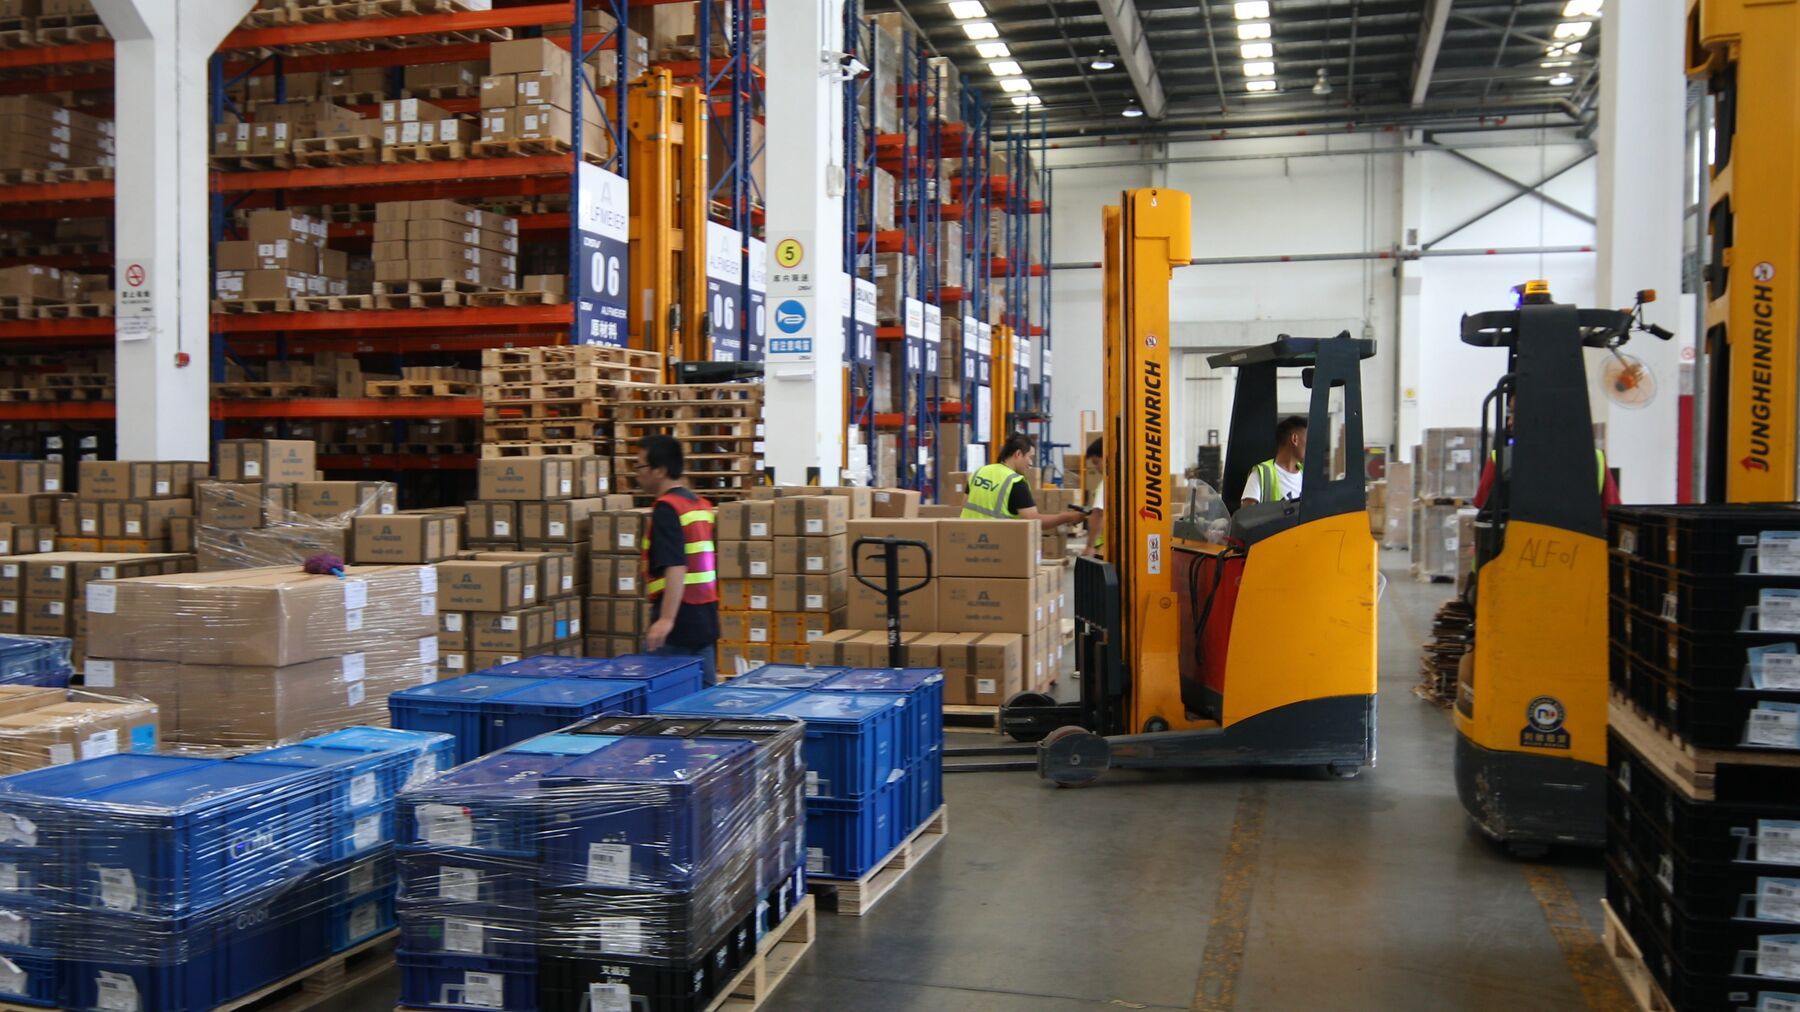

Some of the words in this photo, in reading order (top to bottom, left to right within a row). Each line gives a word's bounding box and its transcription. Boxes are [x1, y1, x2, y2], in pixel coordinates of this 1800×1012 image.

[591, 251, 620, 297] 06
[785, 246, 794, 261] 5
[713, 293, 734, 330] 06
[1750, 285, 1774, 472] JUNGHEINRICH
[1144, 360, 1162, 521] JUNGHEINRICH
[974, 476, 999, 492] DSV
